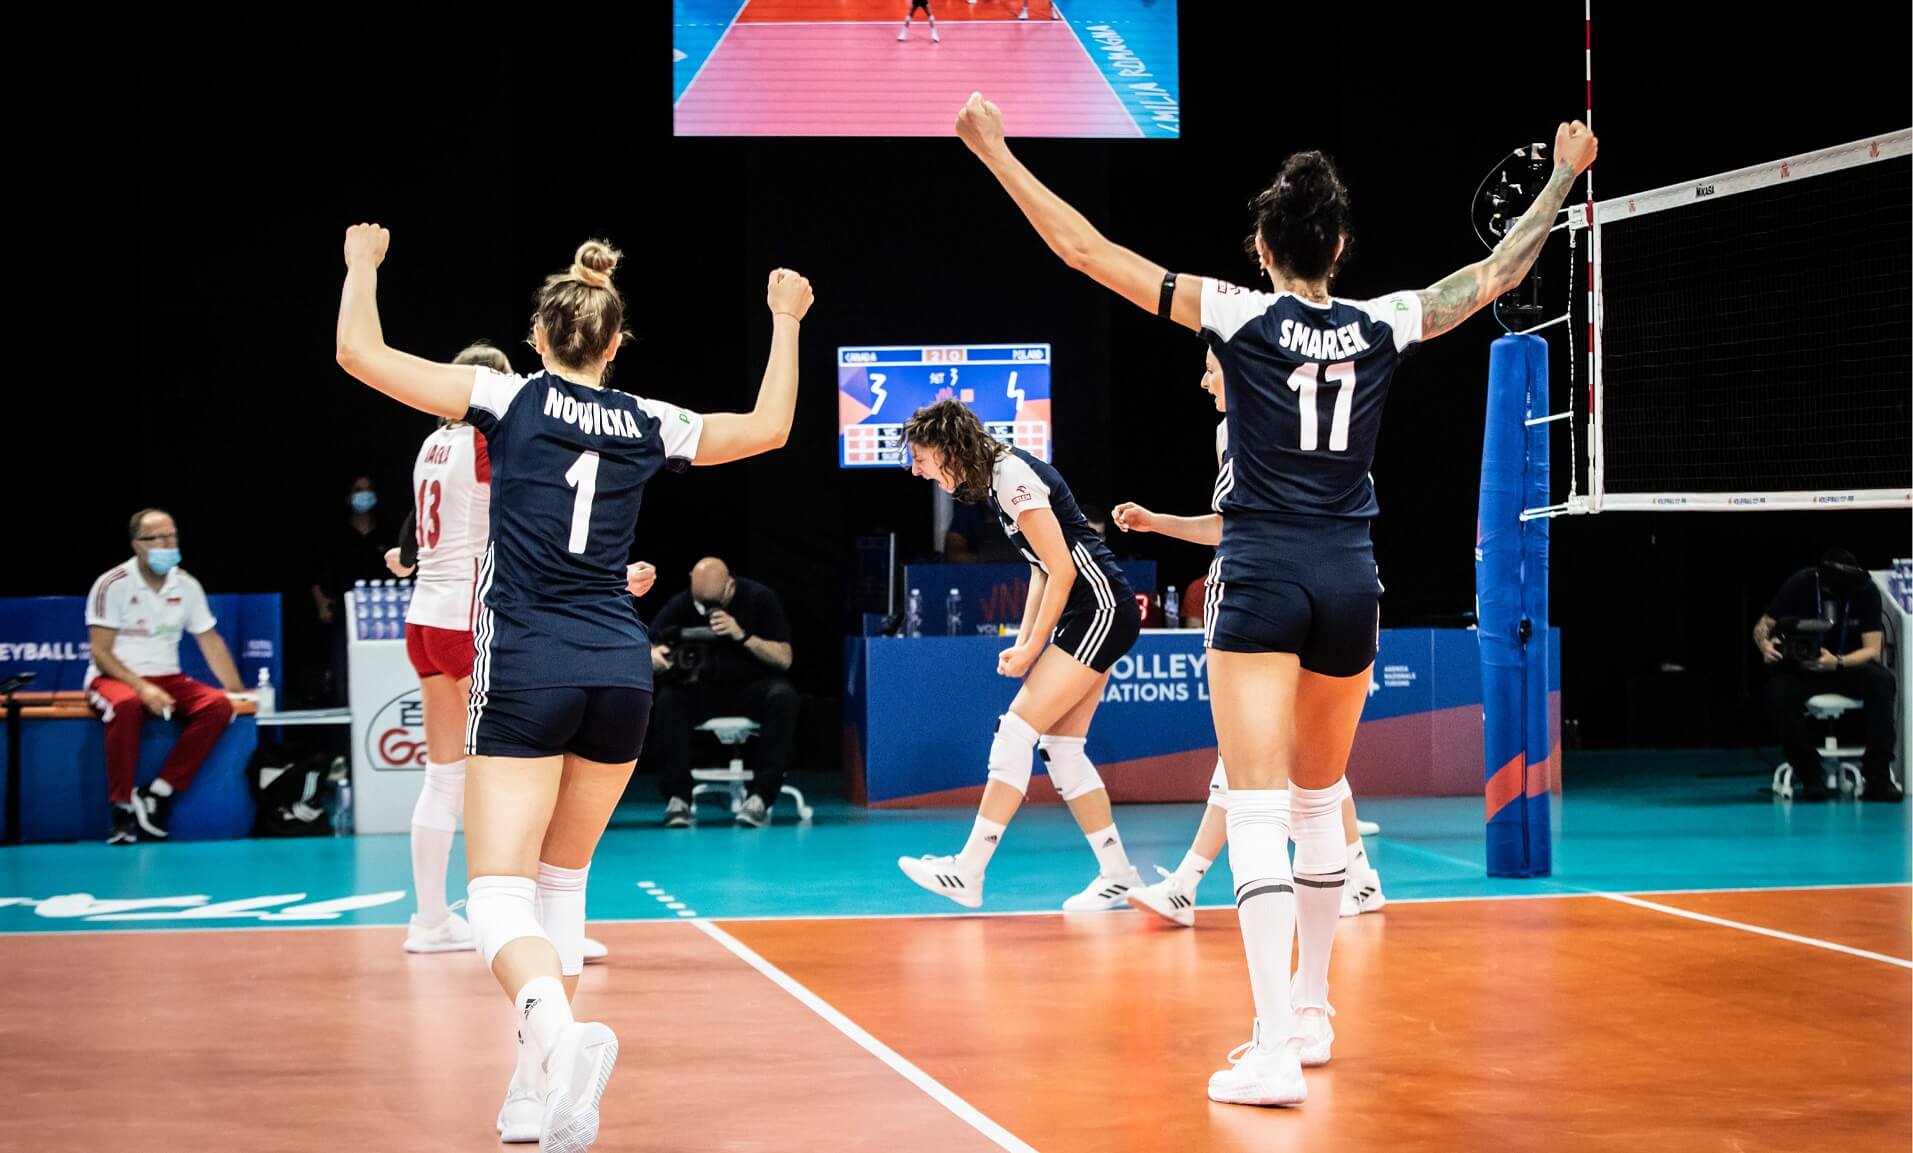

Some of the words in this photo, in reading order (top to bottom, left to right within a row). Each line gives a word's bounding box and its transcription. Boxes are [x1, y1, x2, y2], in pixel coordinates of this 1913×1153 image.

[1085, 24, 1153, 77] ROMAGNA
[869, 373, 888, 415] 3
[950, 367, 959, 387] 3
[1007, 371, 1025, 411] 4
[1287, 361, 1356, 452] 17
[418, 479, 442, 549] 13
[565, 450, 600, 554] 1
[1100, 683, 1189, 702] ATIONS
